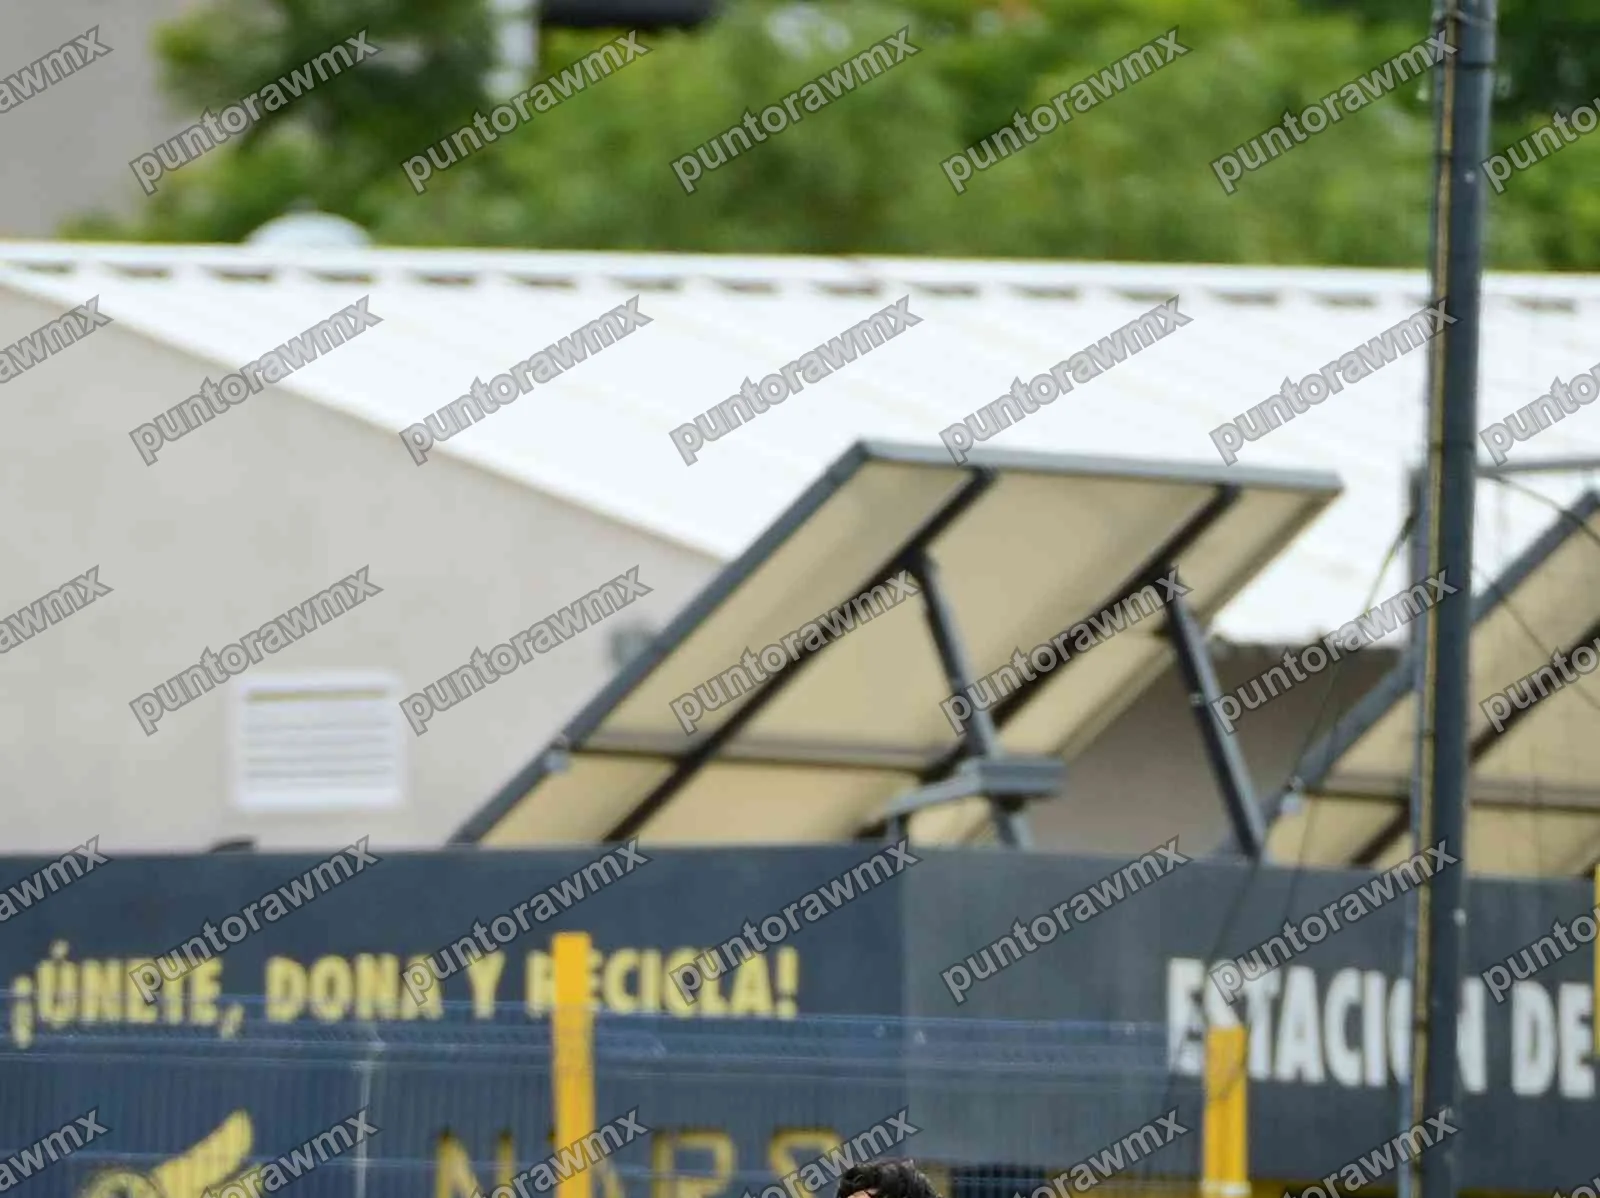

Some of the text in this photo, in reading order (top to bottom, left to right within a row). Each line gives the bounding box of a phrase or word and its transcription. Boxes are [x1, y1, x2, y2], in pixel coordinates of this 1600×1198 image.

[265, 952, 444, 1022] DONA
[466, 950, 506, 1020] Y
[1512, 980, 1596, 1099] DE
